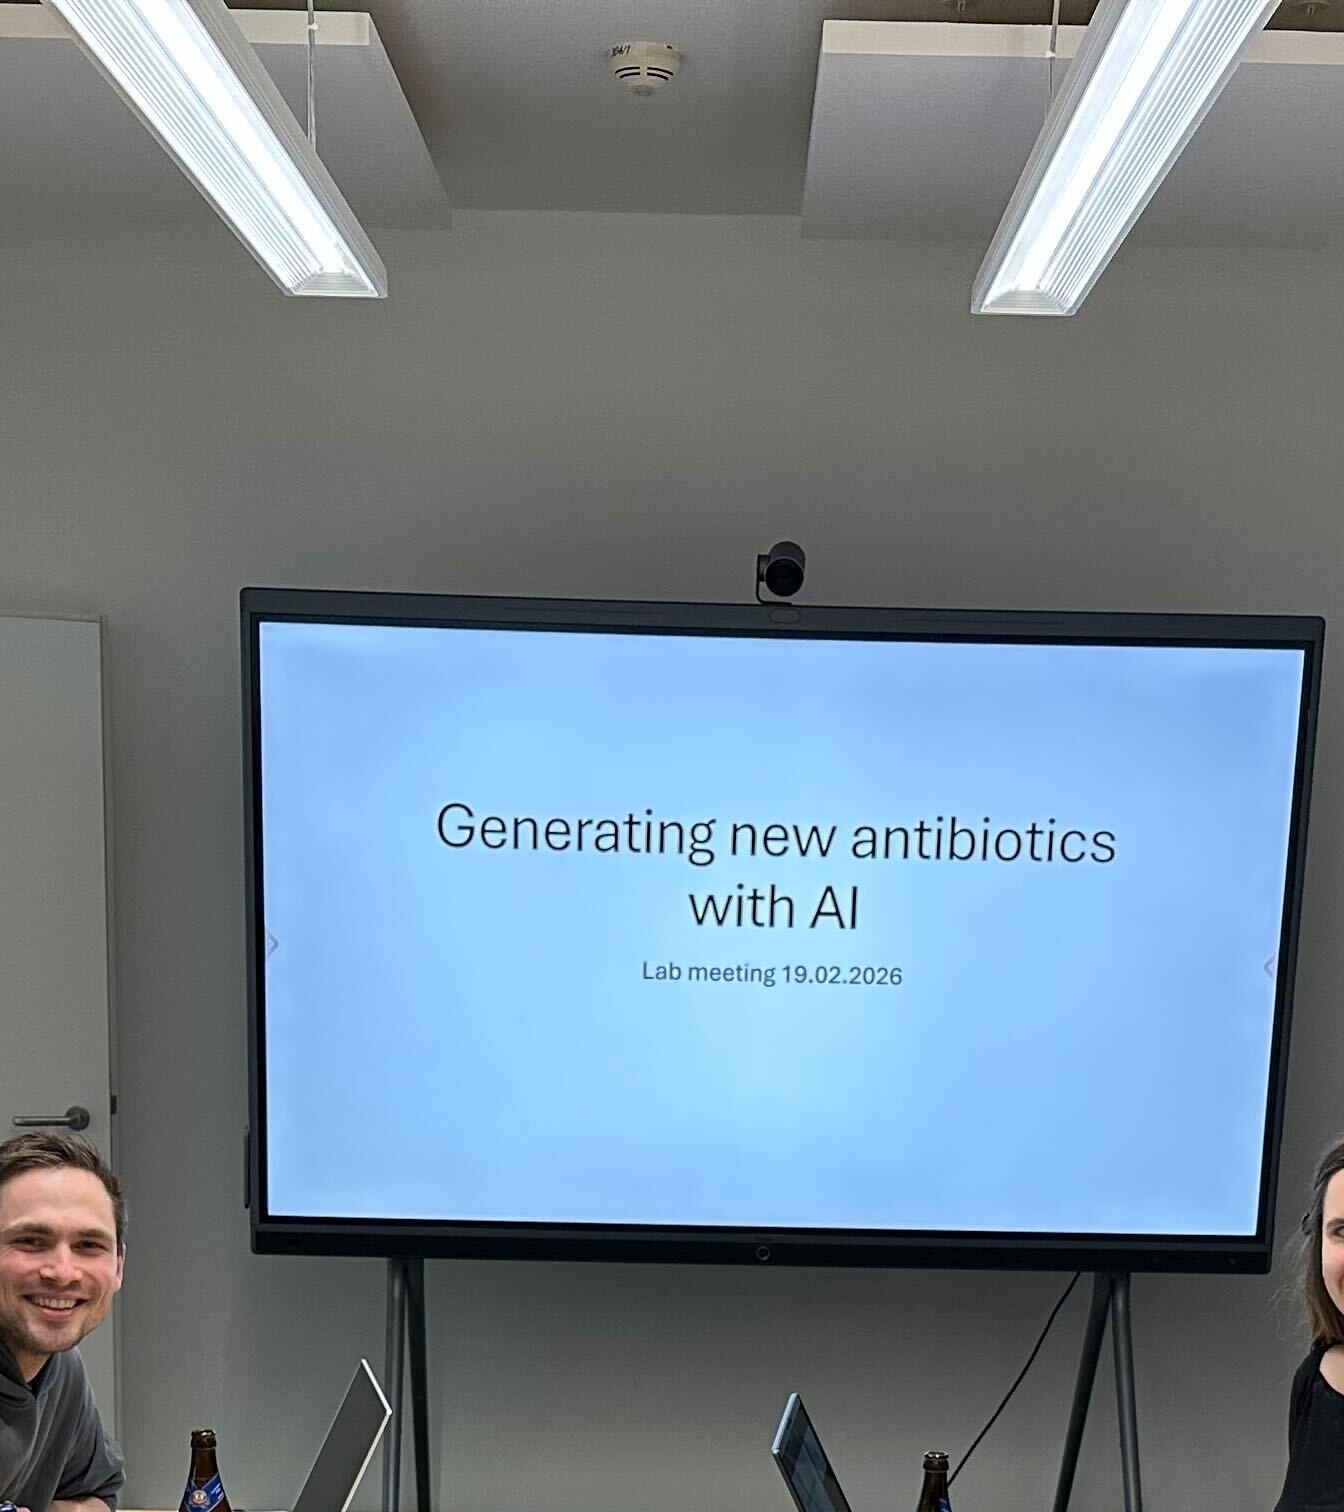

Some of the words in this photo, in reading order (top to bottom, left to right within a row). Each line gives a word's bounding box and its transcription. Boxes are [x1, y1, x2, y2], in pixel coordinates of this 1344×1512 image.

[437, 802, 717, 868] Generating
[730, 823, 838, 858] new
[851, 815, 1117, 864] antibiotics
[687, 882, 795, 929] with
[808, 884, 859, 930] AI
[641, 960, 682, 981] Lab
[687, 962, 777, 988] meeting
[781, 964, 903, 987] 19.02.2026
